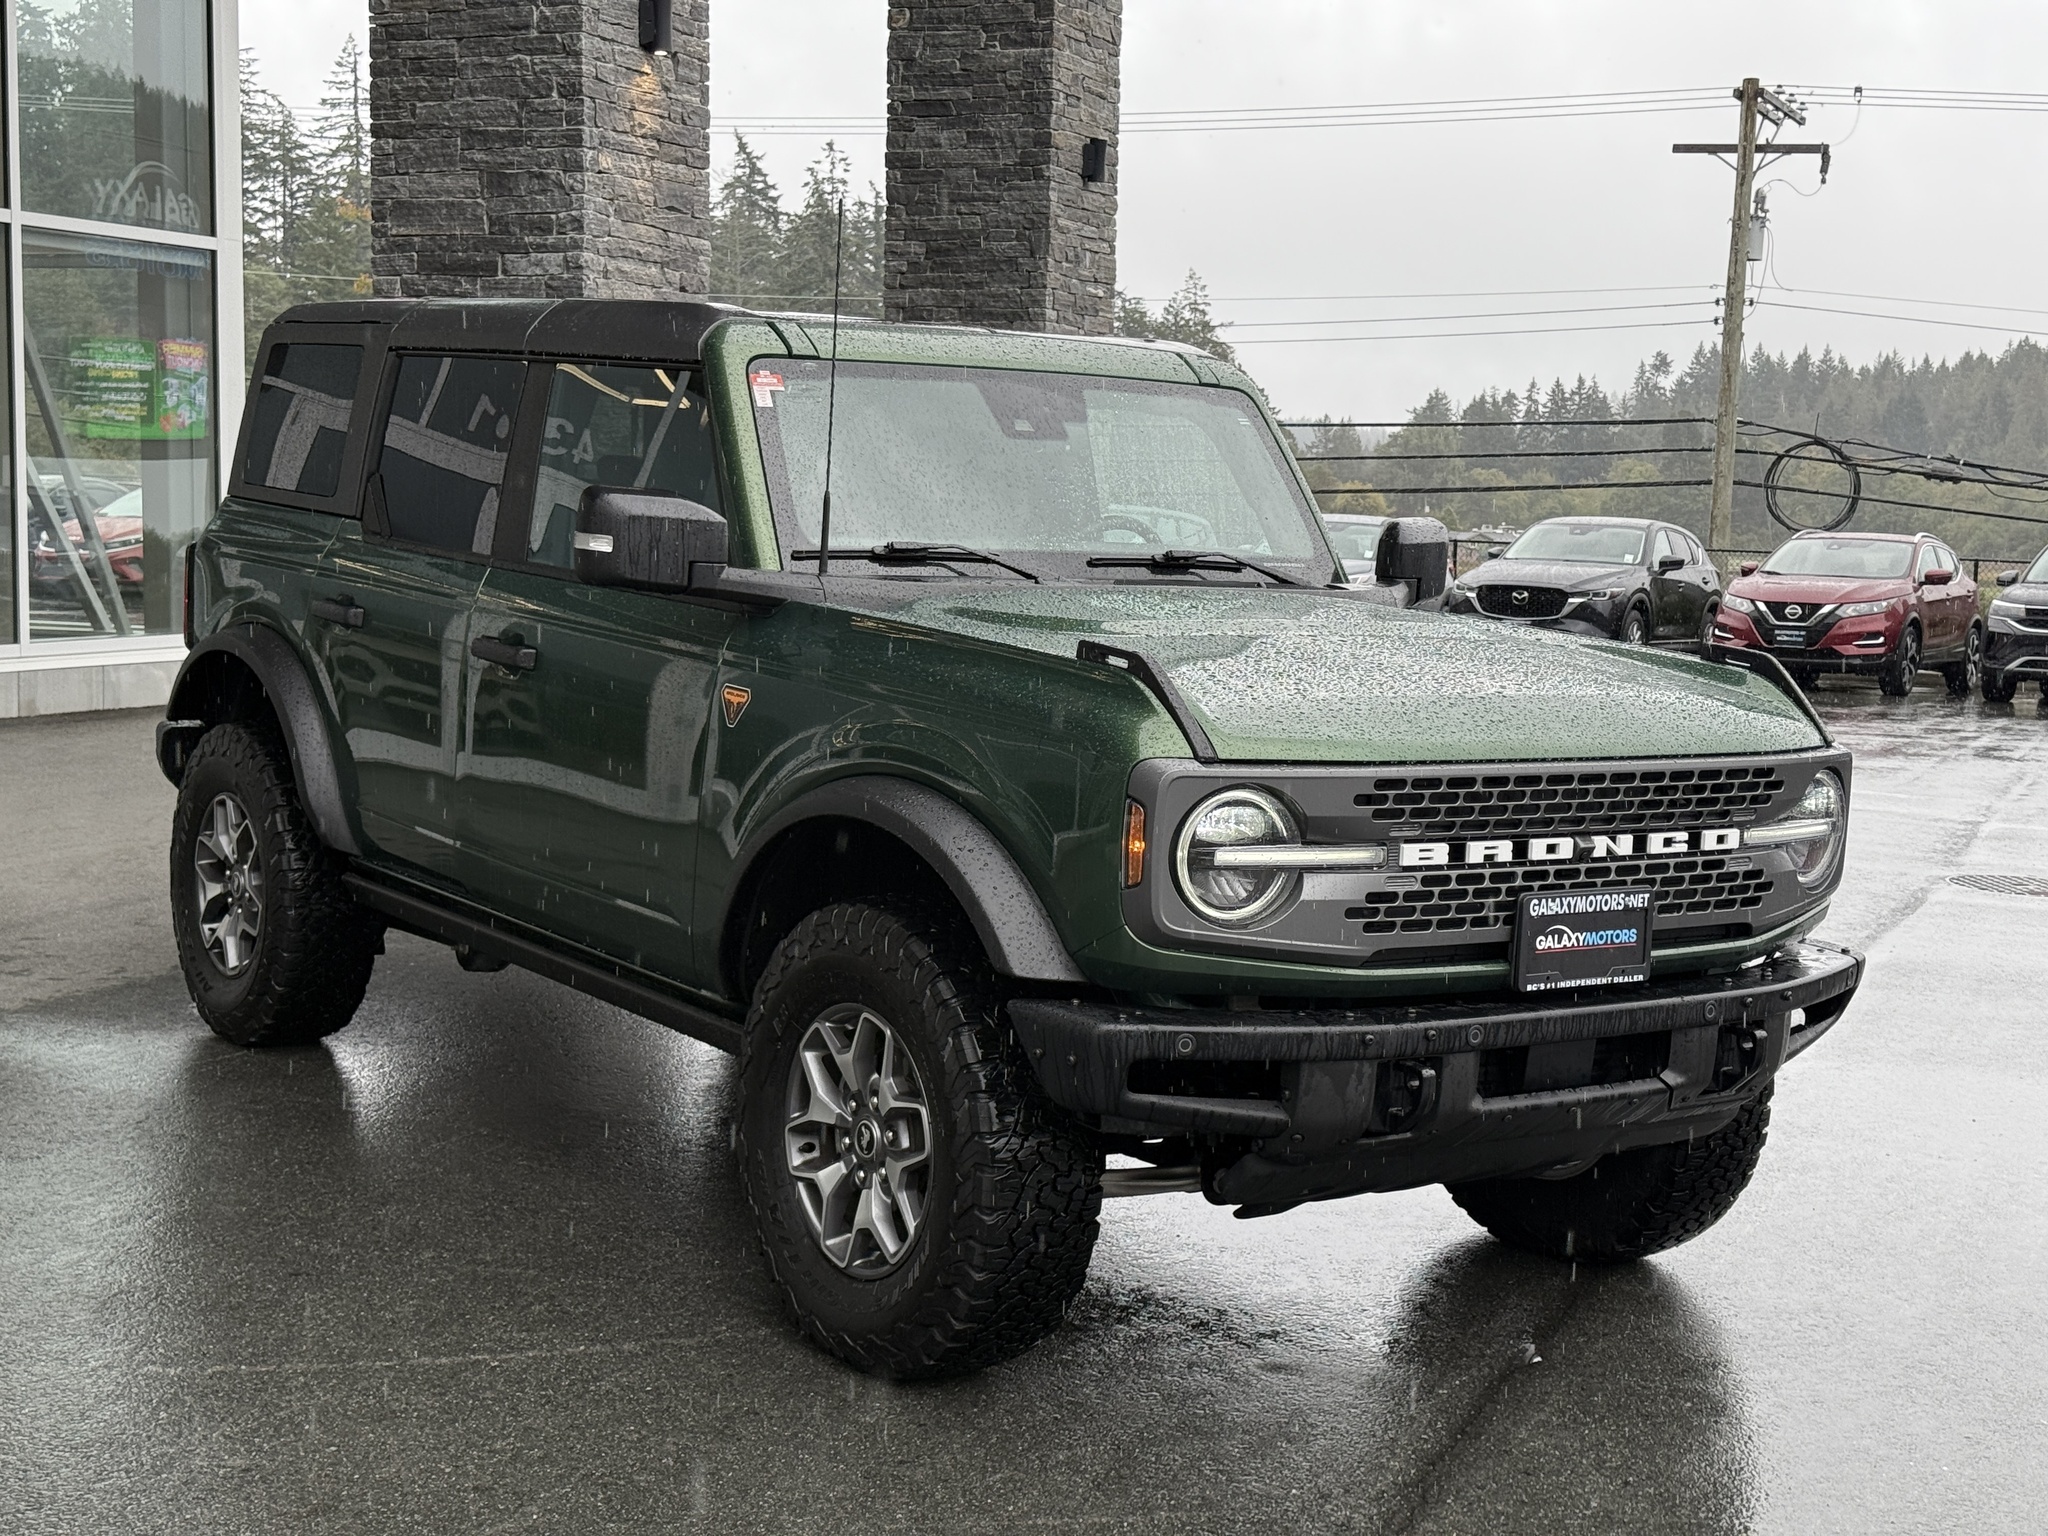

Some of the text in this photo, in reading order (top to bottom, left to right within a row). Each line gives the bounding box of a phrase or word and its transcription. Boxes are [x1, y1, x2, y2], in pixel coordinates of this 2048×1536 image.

[1399, 827, 1741, 867] BRONCO
[1526, 983, 1545, 991] BC'S
[1557, 977, 1612, 988] INDEPENDENT
[1613, 975, 1644, 983] DEALER
